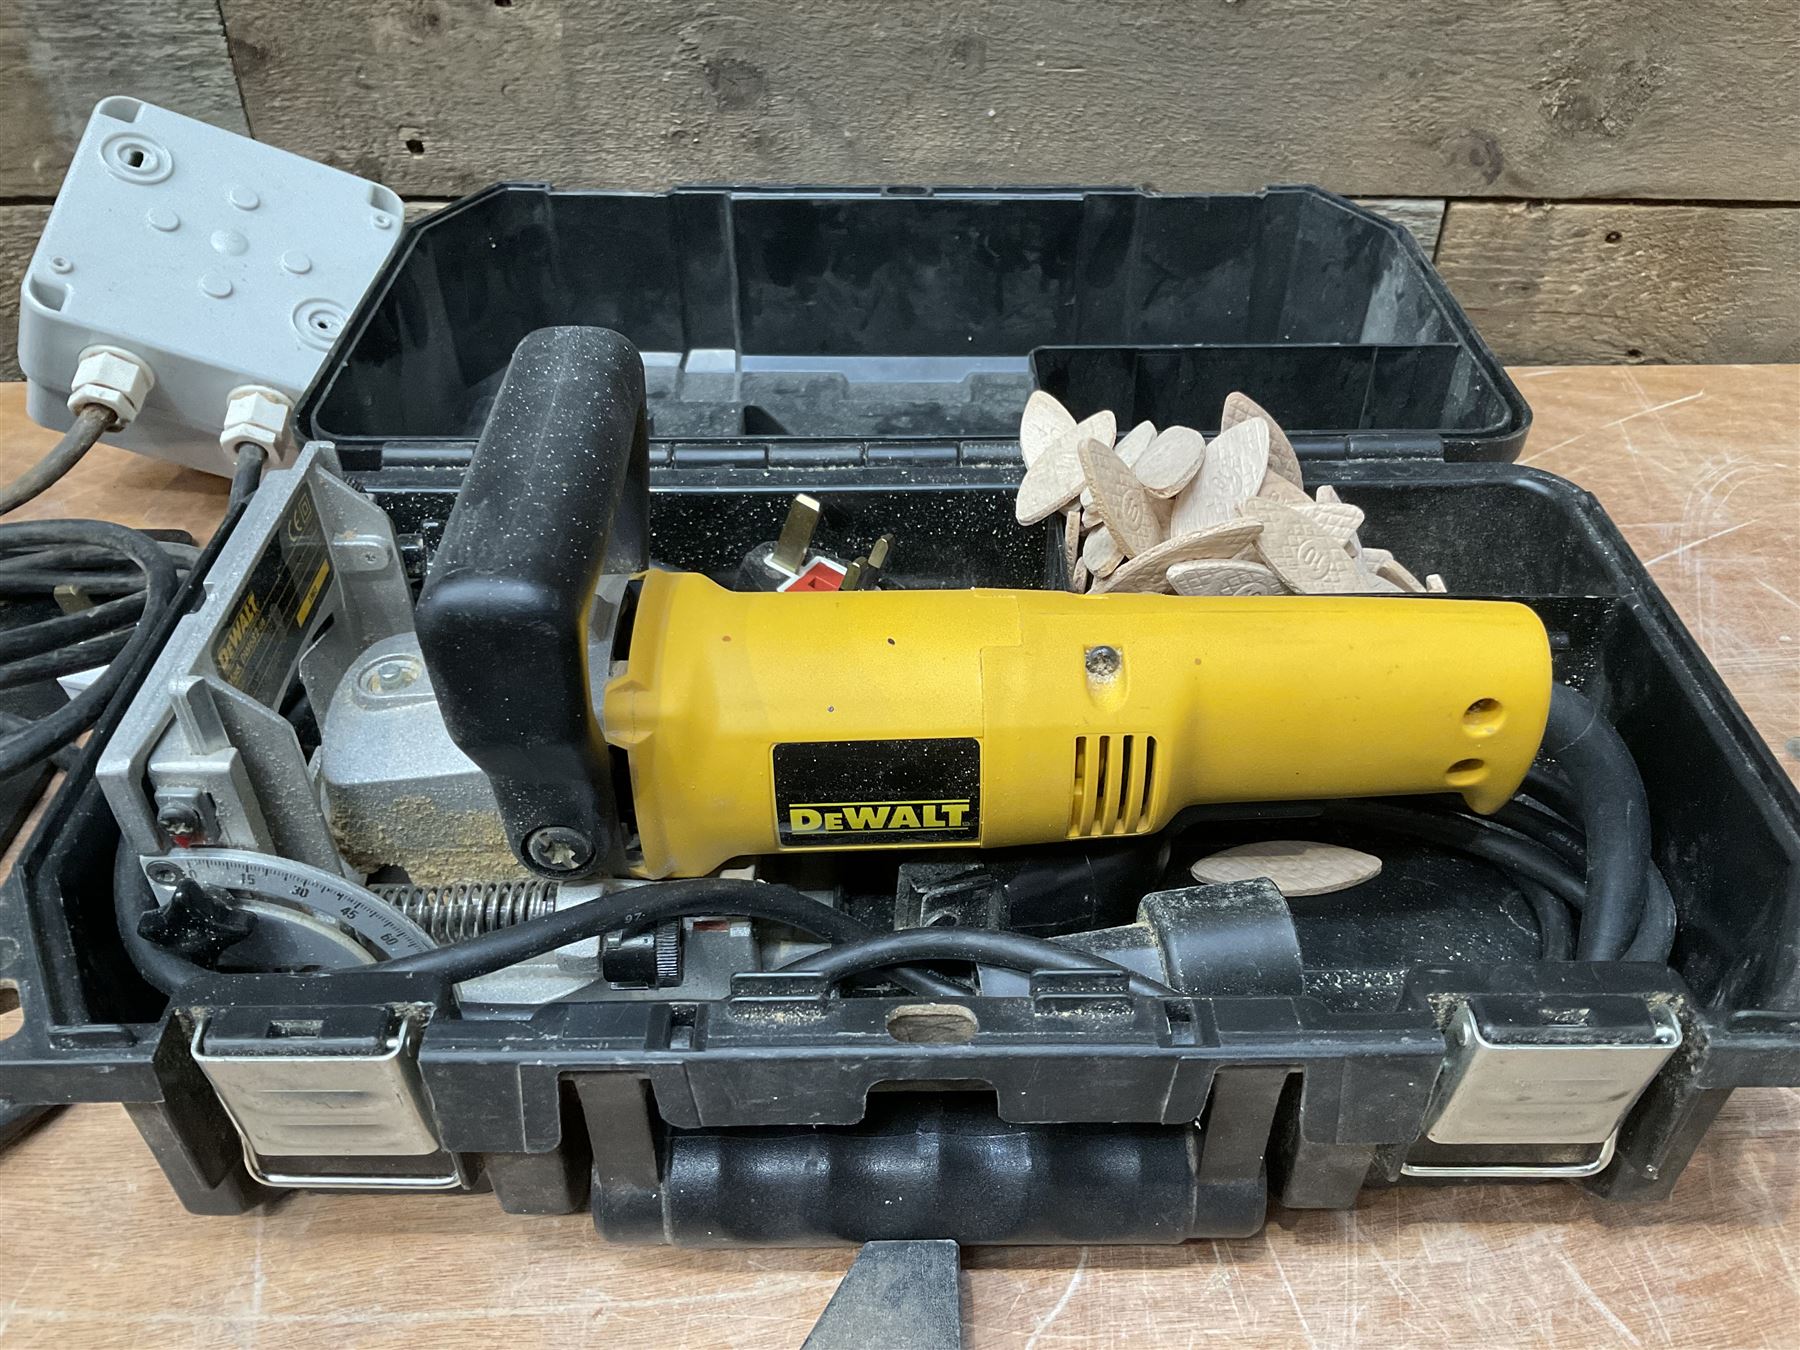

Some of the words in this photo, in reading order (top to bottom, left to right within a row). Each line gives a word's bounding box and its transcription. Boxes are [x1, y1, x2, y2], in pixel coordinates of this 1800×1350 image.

[241, 873, 255, 885] 15
[291, 885, 310, 898] 30
[340, 907, 360, 921] 45
[379, 933, 400, 947] 60
